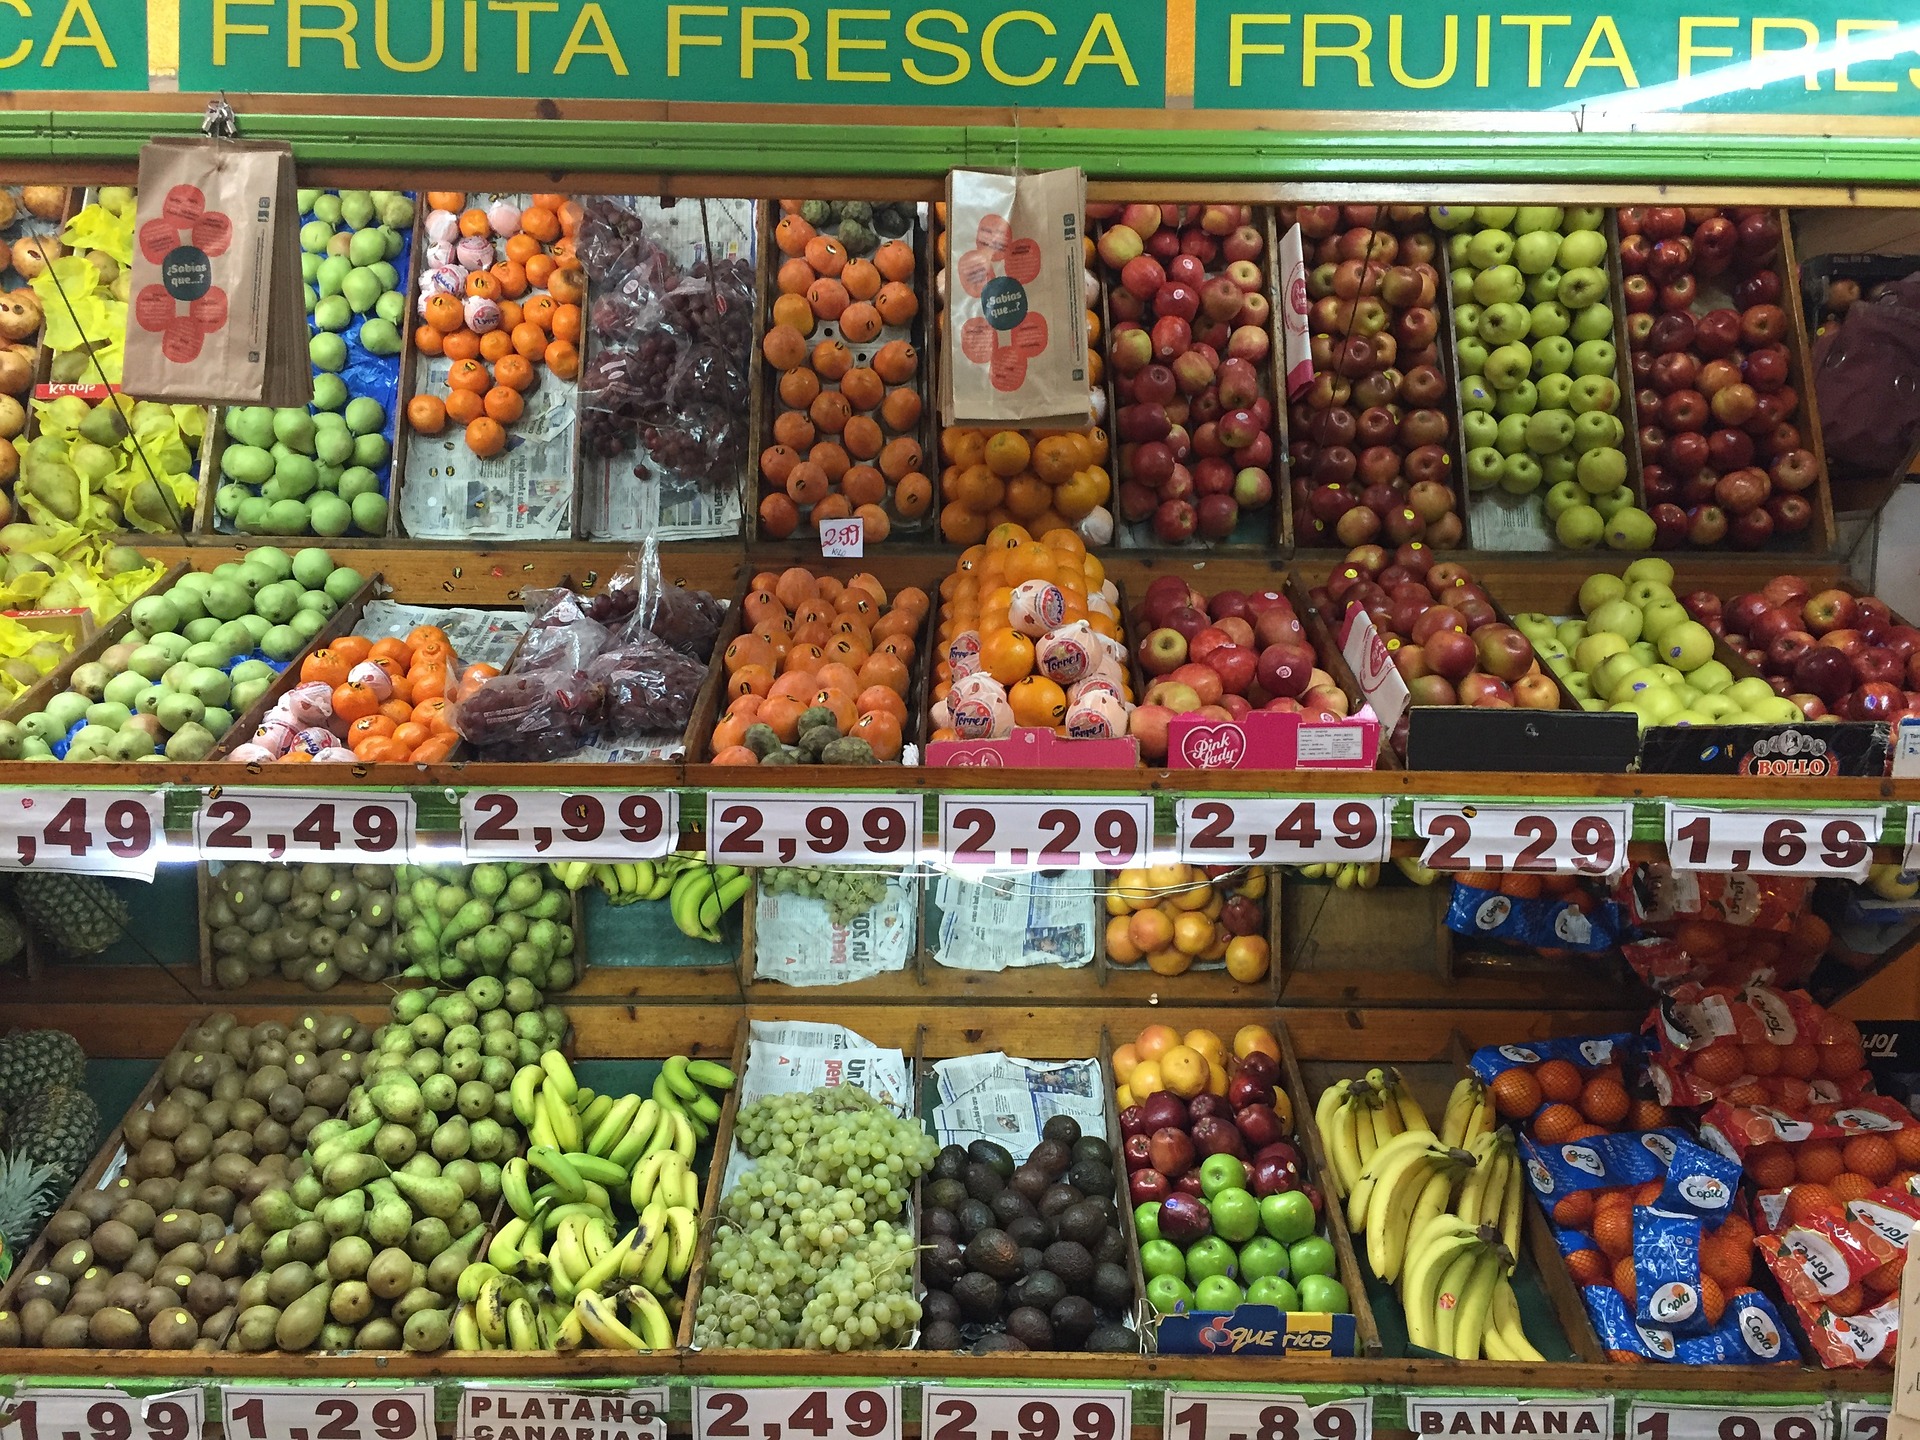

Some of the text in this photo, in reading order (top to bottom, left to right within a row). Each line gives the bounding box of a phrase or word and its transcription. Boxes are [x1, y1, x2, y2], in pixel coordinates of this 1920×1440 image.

[213, 0, 1139, 86] FRUITA FRESCA
[1230, 14, 1920, 93] FRUITA FRE
[1043, 652, 1081, 672] Torres
[955, 712, 990, 727] Torres
[1188, 731, 1231, 758] Pink
[1200, 748, 1236, 768] Lady
[1758, 758, 1825, 776] BOLLO
[206, 801, 398, 859] 2,49
[474, 795, 662, 854] 2,99
[719, 806, 906, 862] 2,99
[1193, 803, 1376, 858] 2,49
[1677, 818, 1868, 872] 1,69
[1793, 1241, 1834, 1288] Torres
[470, 1396, 656, 1425] PLATANO
[706, 1390, 888, 1440] 2,49
[1419, 1410, 1601, 1435] BANANA
[1636, 1411, 1818, 1440] 199
